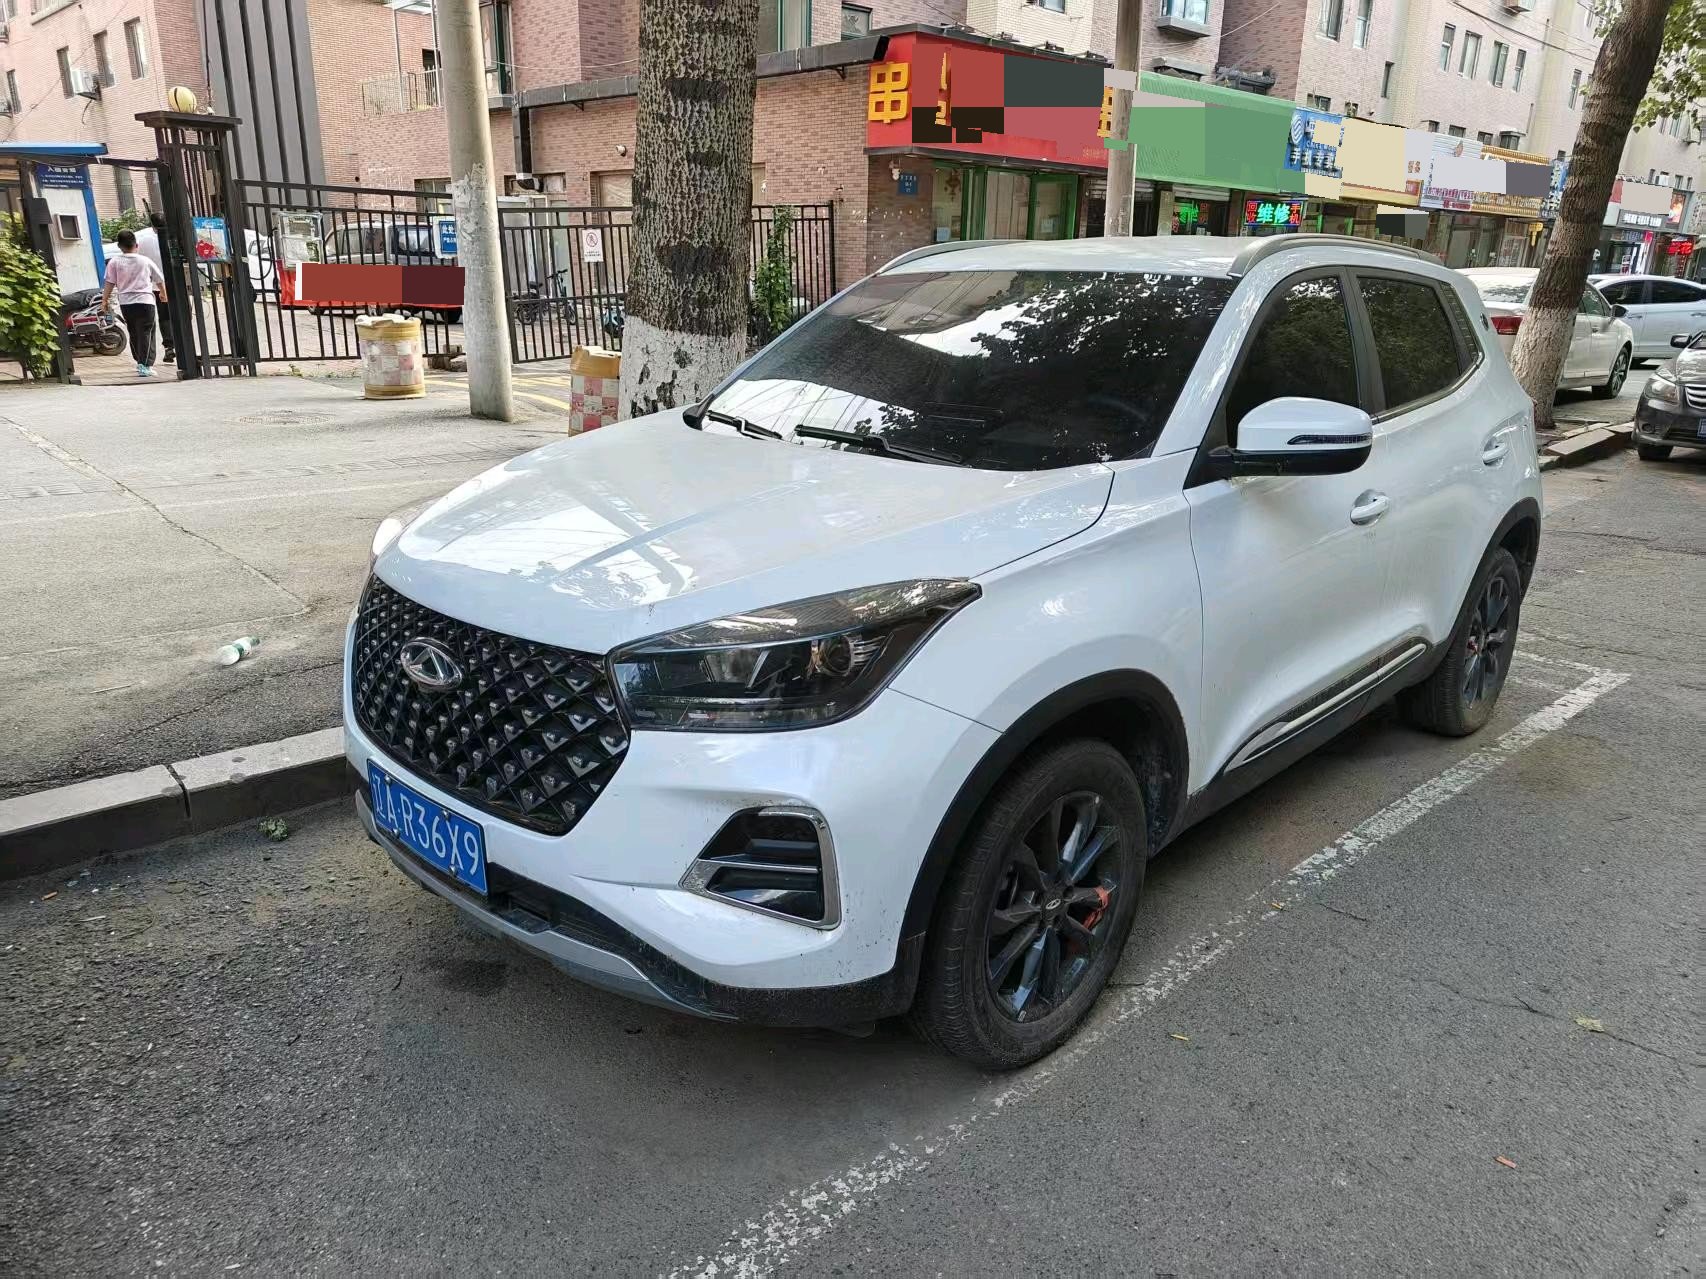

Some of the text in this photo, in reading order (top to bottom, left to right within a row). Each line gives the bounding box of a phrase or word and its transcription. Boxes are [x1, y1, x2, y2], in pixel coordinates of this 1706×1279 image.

[868, 61, 910, 124] 串
[1257, 203, 1290, 224] 维修
[1289, 203, 1301, 224] 手机
